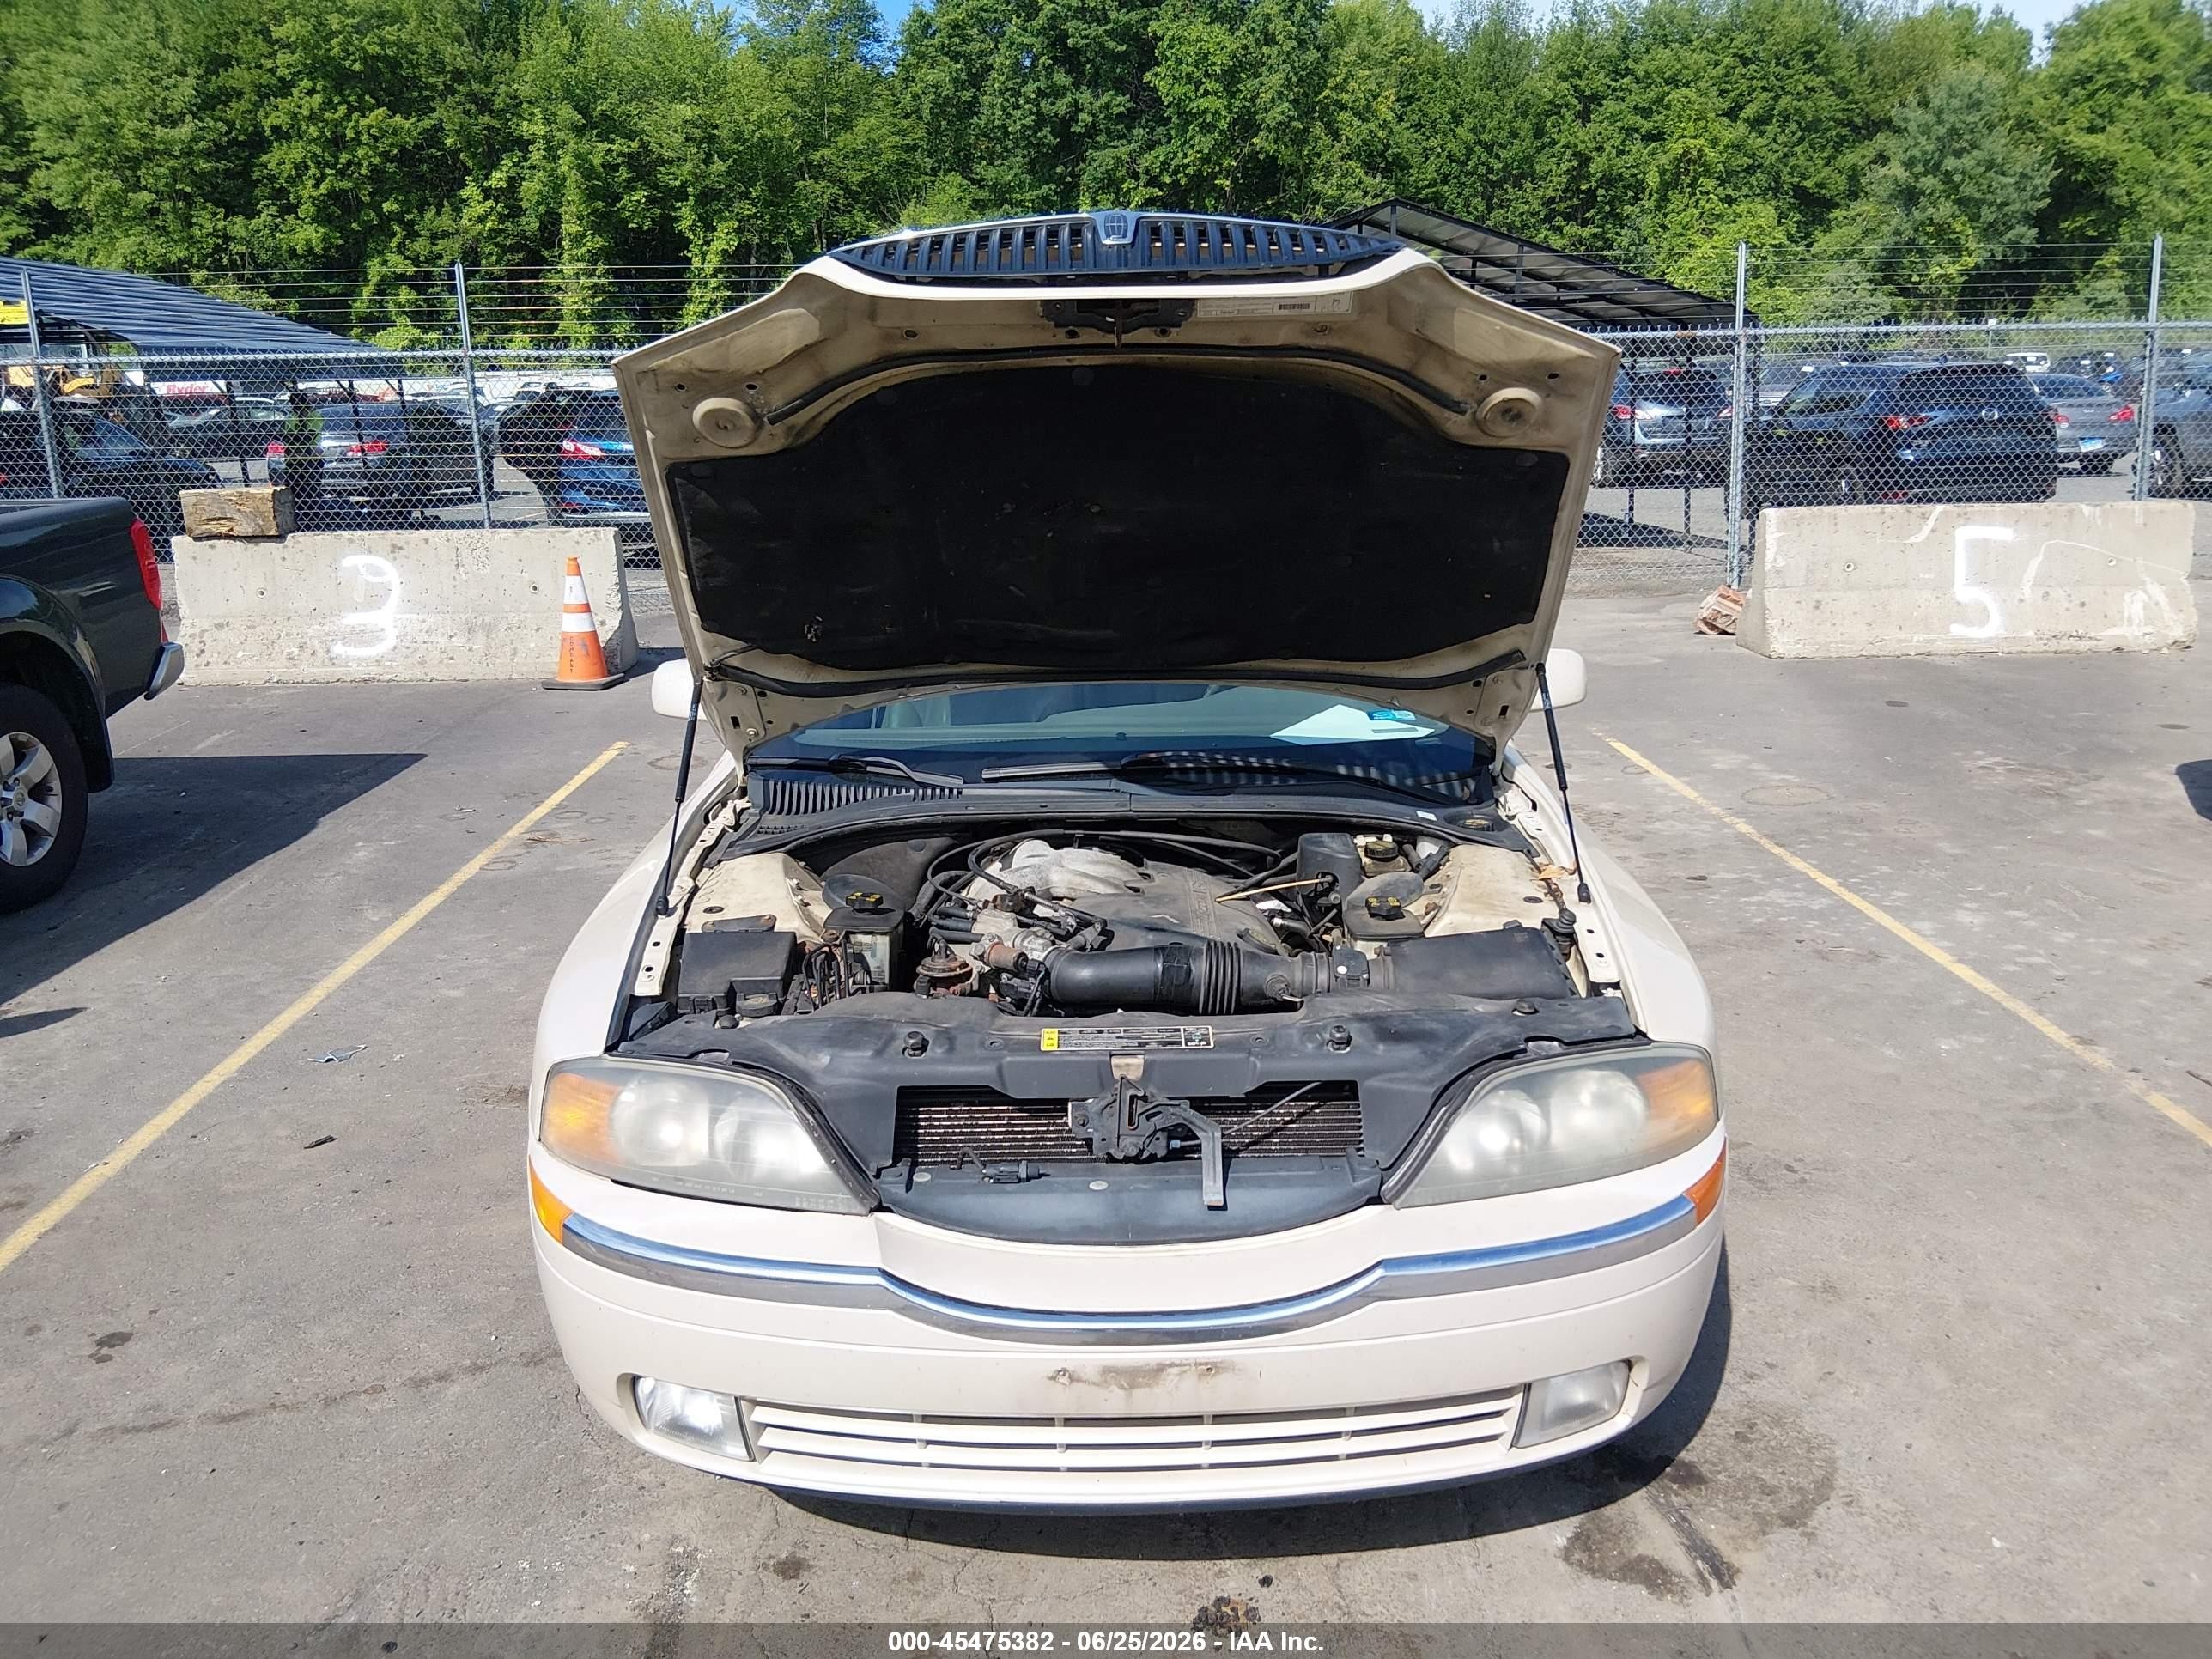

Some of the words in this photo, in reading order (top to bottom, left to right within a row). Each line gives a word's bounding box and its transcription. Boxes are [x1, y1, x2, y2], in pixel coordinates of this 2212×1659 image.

[167, 384, 209, 394] Ryder
[332, 554, 399, 656] 3
[1949, 525, 2014, 638] 5
